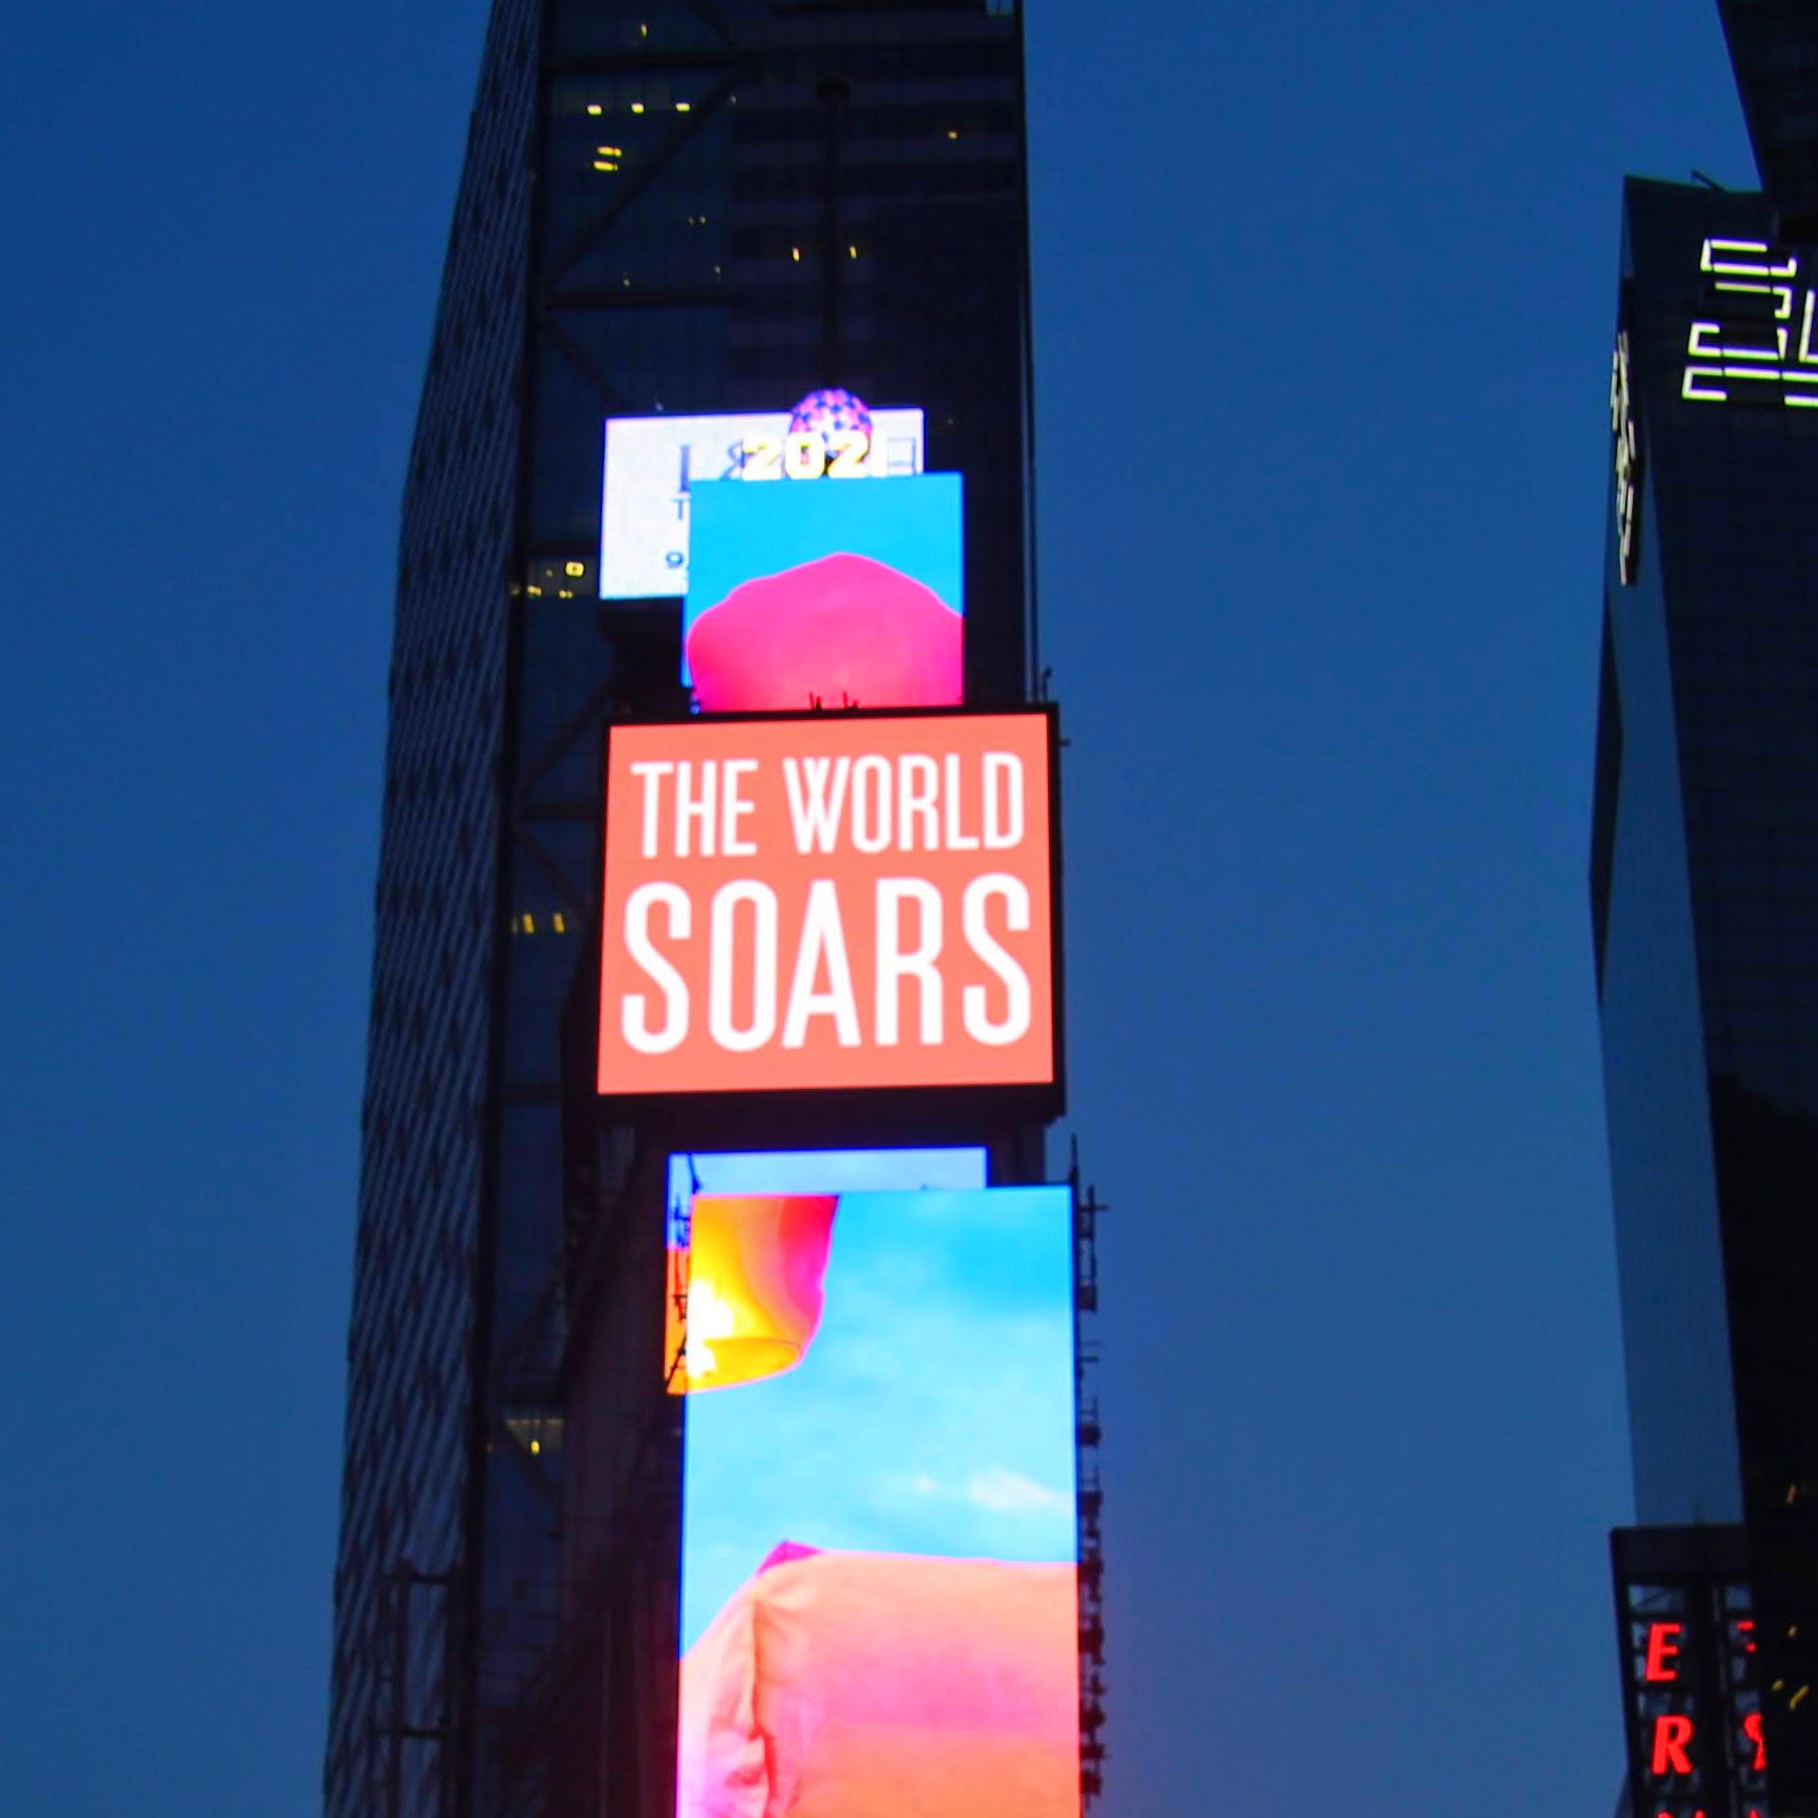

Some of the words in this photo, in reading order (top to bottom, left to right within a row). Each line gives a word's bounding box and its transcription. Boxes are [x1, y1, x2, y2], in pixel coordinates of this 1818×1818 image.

[630, 758, 759, 859] THE
[783, 752, 1025, 855] WORLD
[620, 873, 1032, 1055] SOARS
